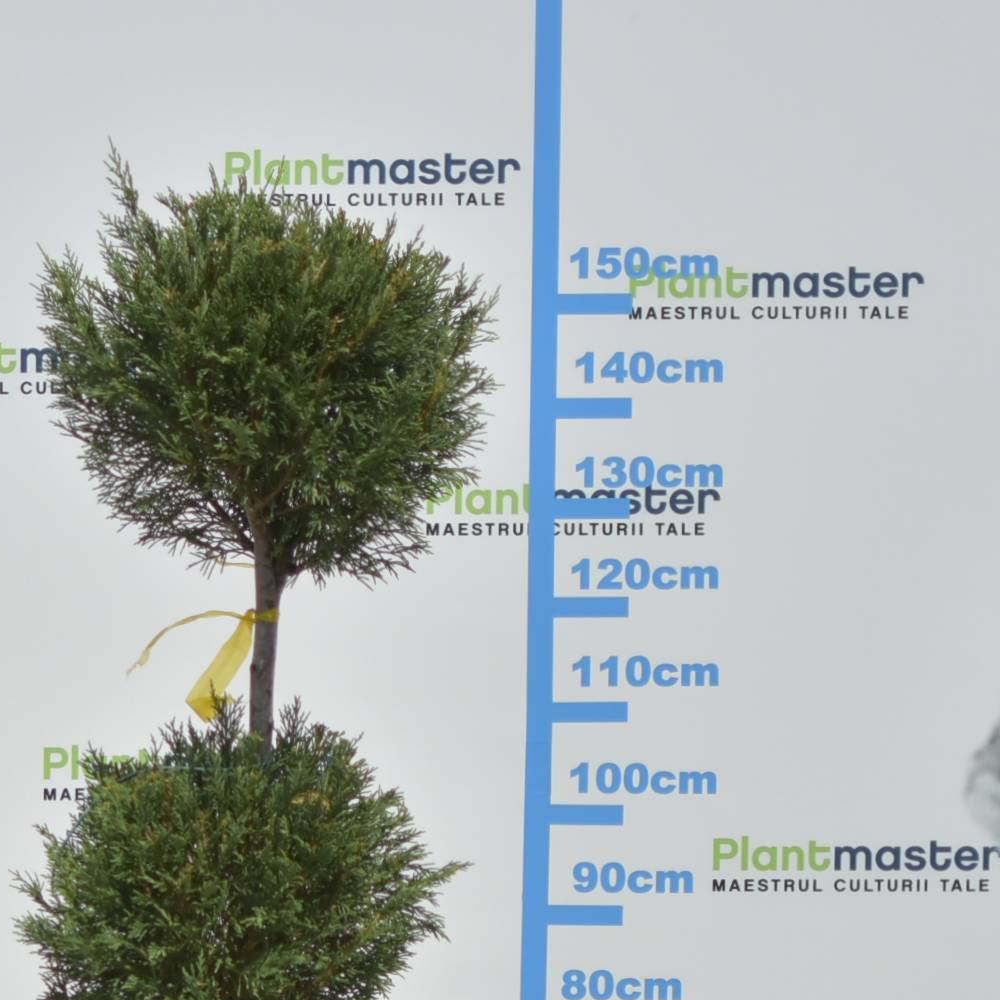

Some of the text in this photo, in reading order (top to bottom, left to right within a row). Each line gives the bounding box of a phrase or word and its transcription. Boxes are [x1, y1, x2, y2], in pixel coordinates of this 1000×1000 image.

[225, 150, 520, 186] Plantmaster
[348, 193, 443, 206] CULTURII
[455, 192, 504, 206] TALE
[570, 247, 718, 279] 150cm
[629, 306, 908, 320] MAESTRUL CULTURII TALE
[576, 352, 723, 383] 140cm
[575, 456, 723, 488] 130cm
[426, 523, 529, 536] MAESTRU
[655, 523, 704, 536] TALE
[572, 559, 719, 589] 120cm
[573, 656, 719, 687] 110cm
[571, 762, 717, 794] 100cm
[712, 836, 1000, 871] Plantmaster
[573, 862, 693, 893] 90cm
[712, 879, 989, 892] MAESTRUL CULTURII TALE
[562, 970, 682, 1000] 80cm
